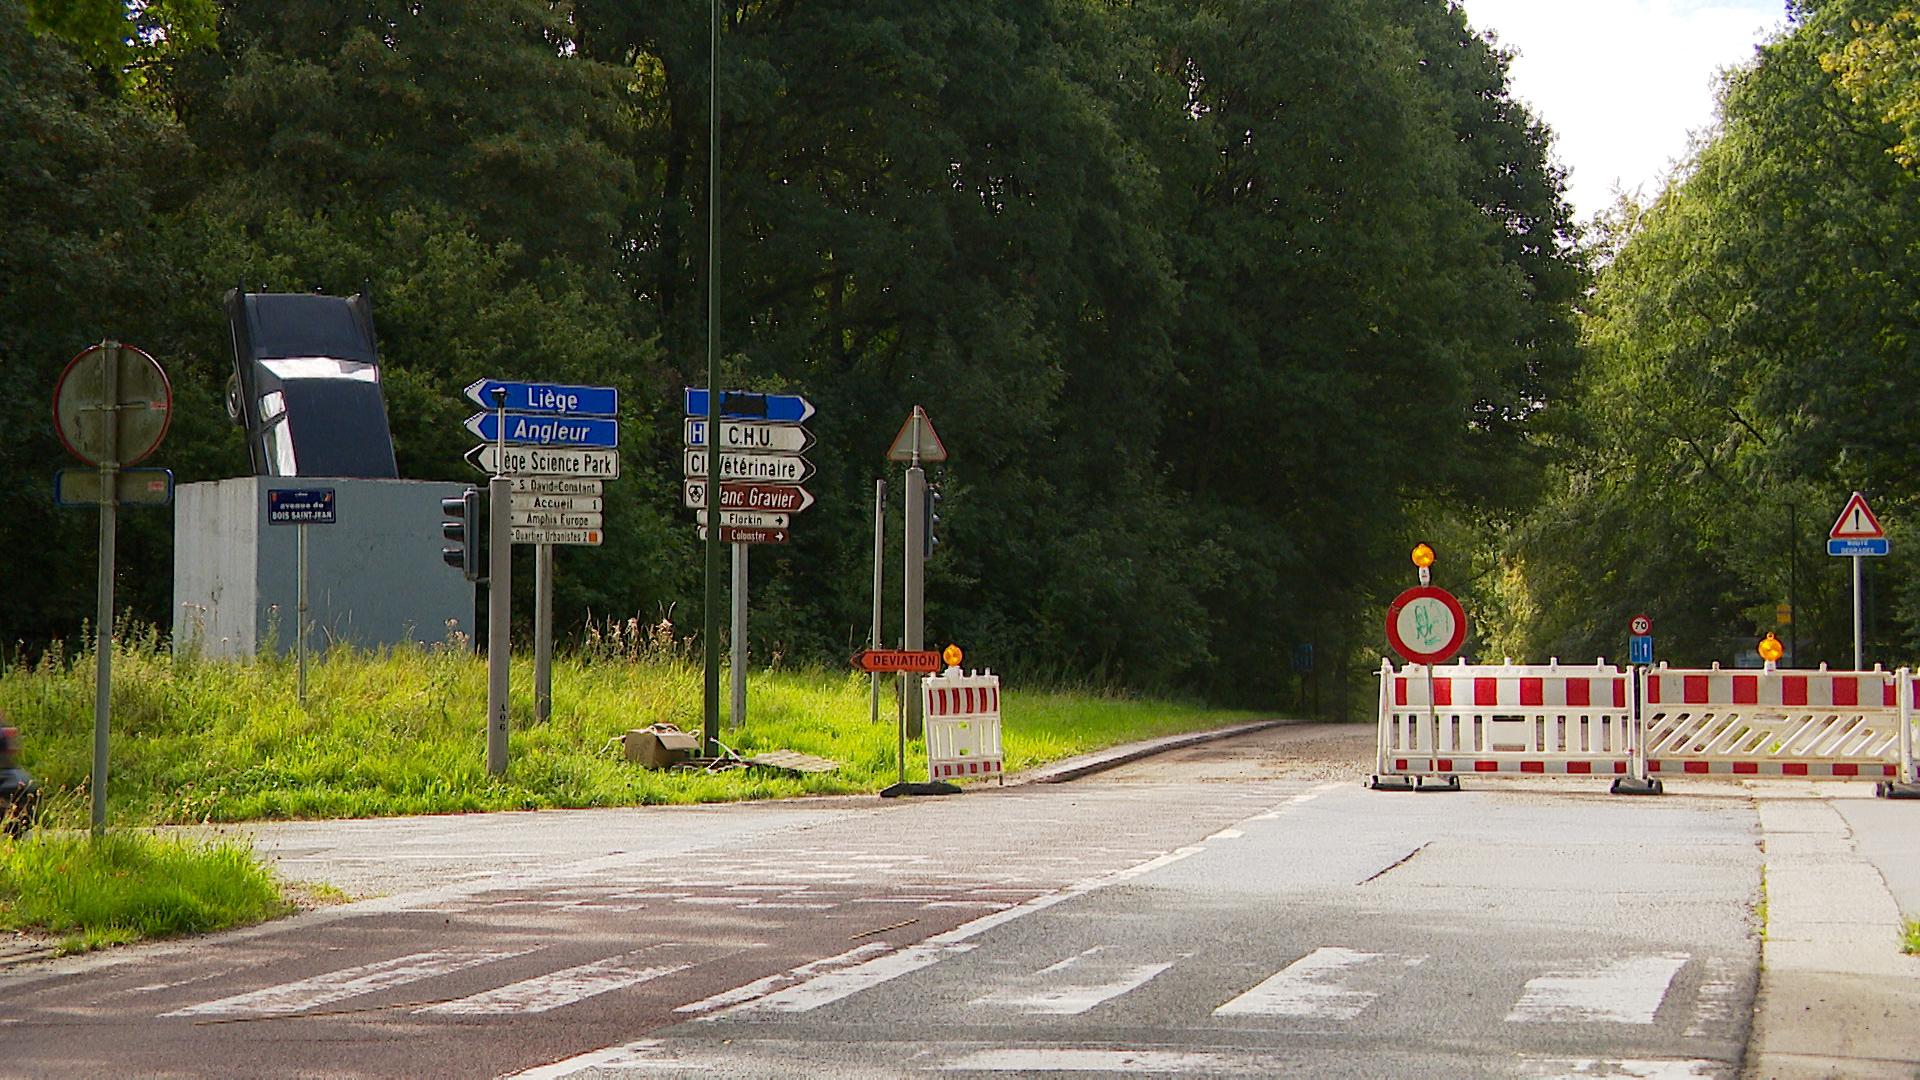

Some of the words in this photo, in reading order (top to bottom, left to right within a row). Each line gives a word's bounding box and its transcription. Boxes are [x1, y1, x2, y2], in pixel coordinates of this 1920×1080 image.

[528, 387, 578, 412] Liège
[514, 419, 590, 444] Angleur
[728, 425, 774, 447] C.H.U.
[492, 450, 526, 473] Lège
[531, 451, 579, 472] Science
[584, 453, 612, 474] Park
[534, 496, 573, 510] Accueil
[720, 486, 744, 506] lanc
[749, 487, 795, 508] Gravier
[272, 511, 290, 520] BOIS
[527, 512, 557, 526] Amphis
[560, 513, 589, 526] Europe
[1634, 620, 1647, 630] 70
[873, 655, 936, 666] DEVIATION
